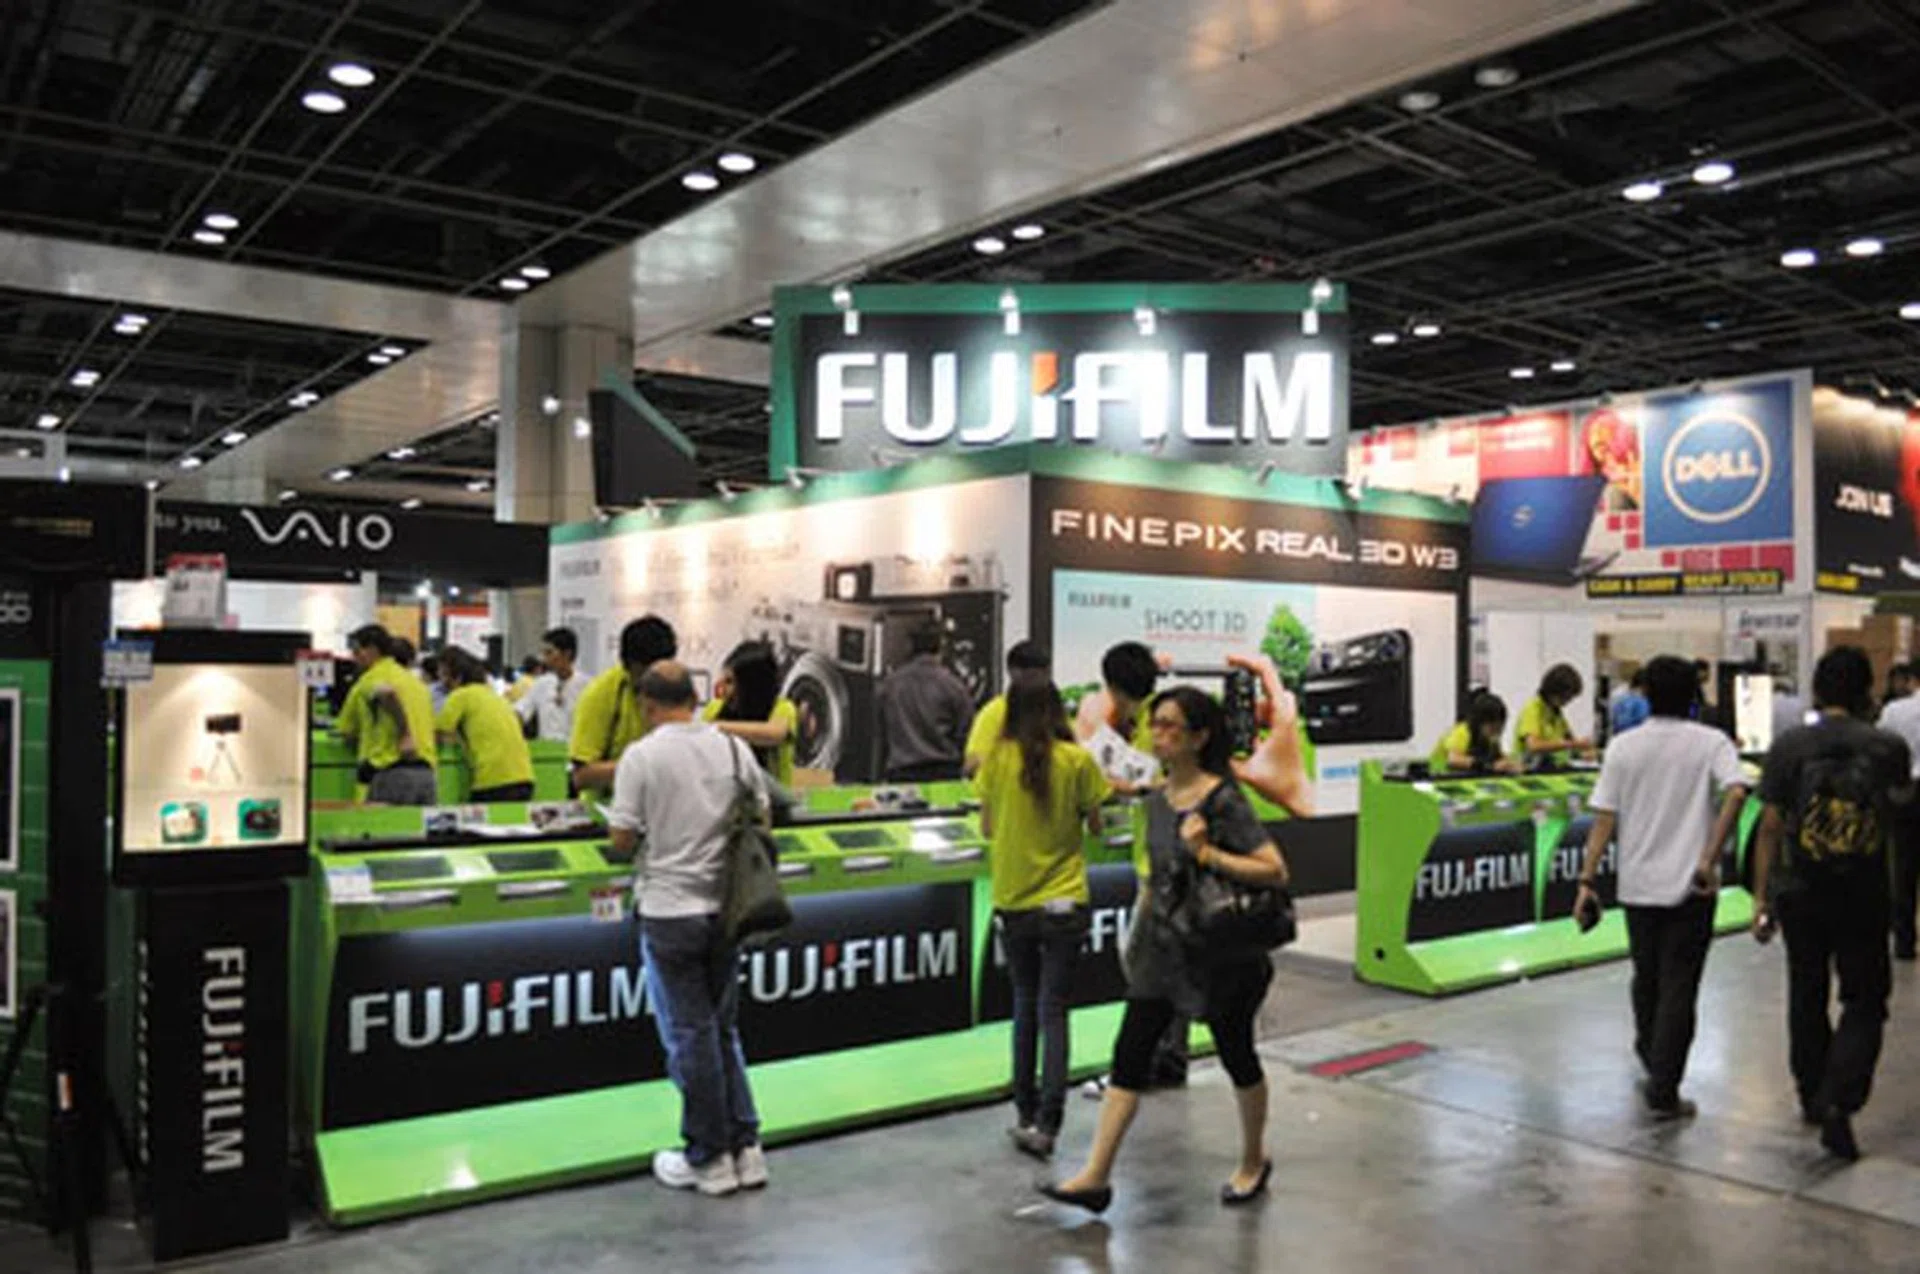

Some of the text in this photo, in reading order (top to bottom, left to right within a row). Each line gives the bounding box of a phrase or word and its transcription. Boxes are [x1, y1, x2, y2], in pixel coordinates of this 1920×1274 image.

[814, 350, 1334, 444] FUJIFILM
[1675, 448, 1759, 482] DELL
[241, 508, 393, 550] VAIO
[1051, 508, 1459, 570] FINEPIX REAL 3D W3
[1416, 852, 1530, 900] FUJIFILM
[349, 964, 656, 1055] FUJIFILM
[202, 947, 246, 1173] FUJIFILM
